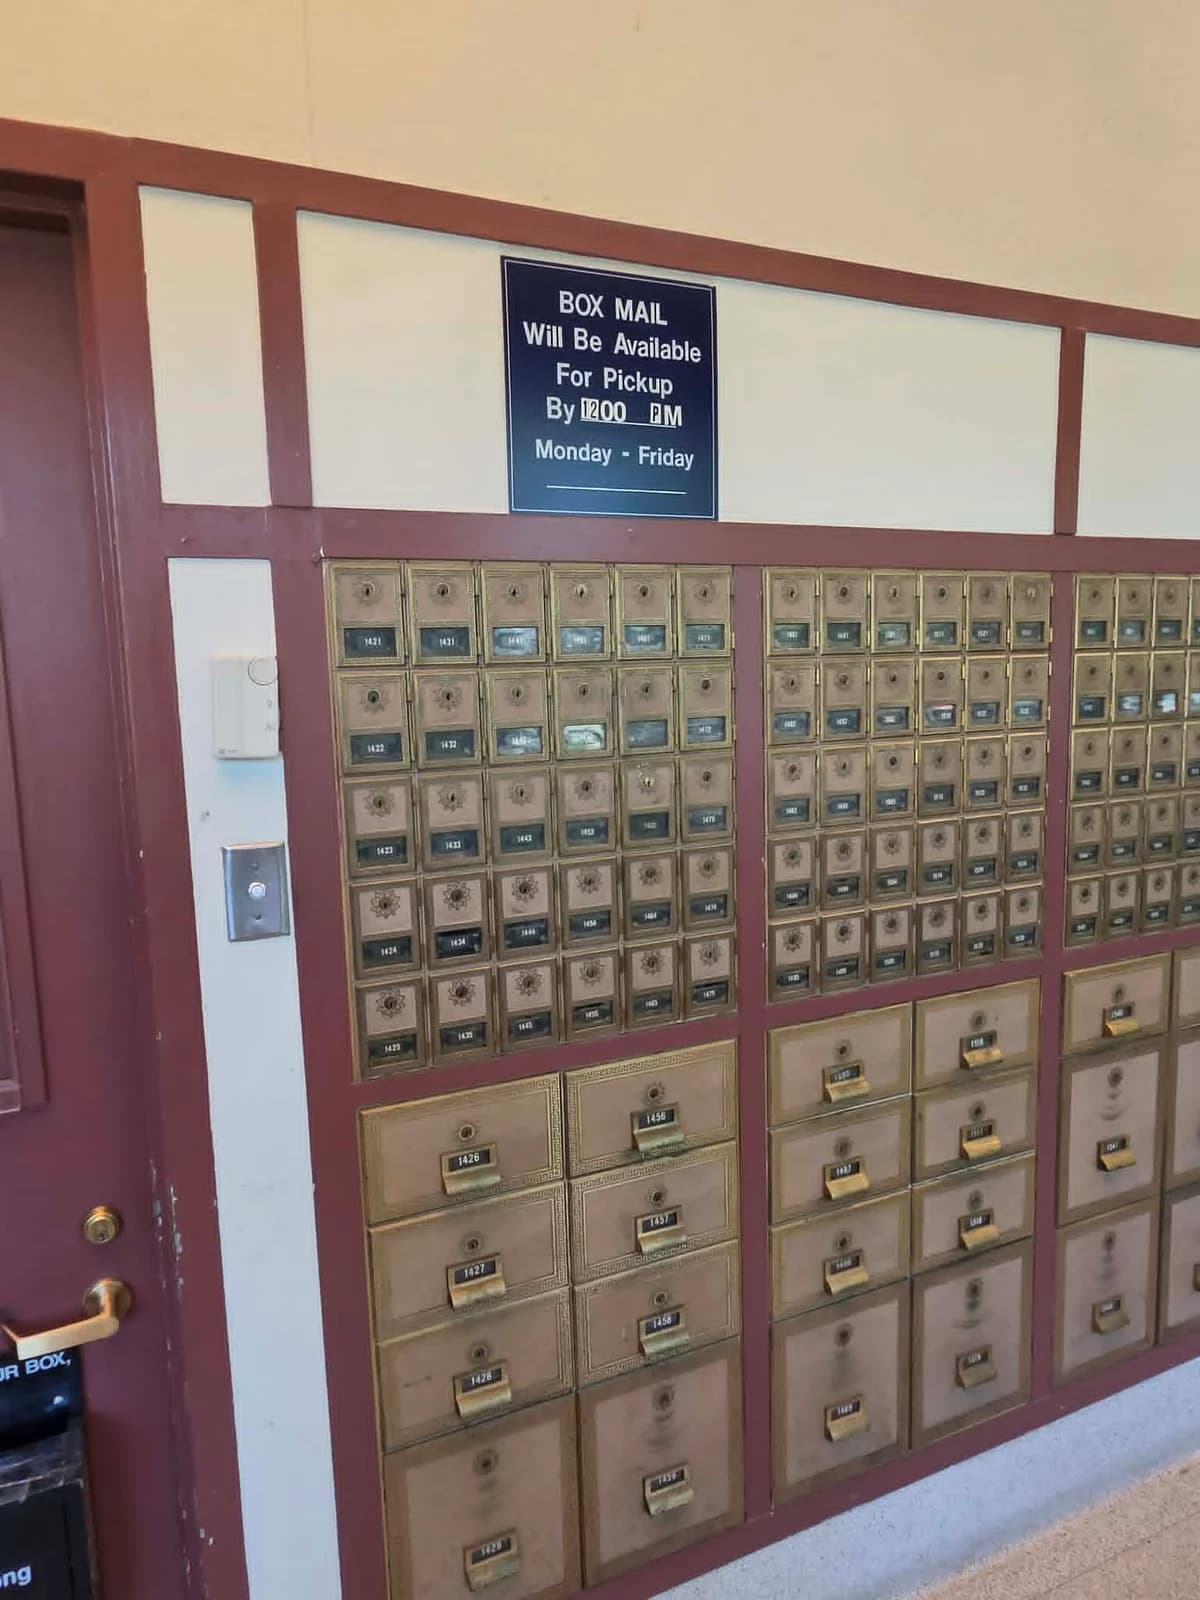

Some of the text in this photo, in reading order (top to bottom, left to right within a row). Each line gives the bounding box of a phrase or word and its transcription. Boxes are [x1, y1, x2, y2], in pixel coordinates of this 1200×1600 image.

[559, 290, 668, 326] BOX MAIL
[523, 321, 701, 363] Will Be Available
[557, 362, 673, 399] For Pickup
[546, 396, 575, 425] By
[650, 402, 682, 427] PM
[535, 439, 612, 466] Monday
[639, 446, 694, 471] Friday
[364, 637, 382, 646] 1421
[439, 638, 455, 646] 1431
[367, 744, 384, 753] 1422
[377, 846, 393, 855] 1423
[450, 938, 466, 947] 1434
[381, 947, 397, 956] 1424
[646, 1112, 666, 1124] 1456
[458, 1152, 480, 1166] 1426
[650, 1215, 669, 1227] 1457
[464, 1263, 485, 1278] 1427
[25, 1352, 71, 1375] BOX,
[470, 1371, 492, 1386] 1428
[0, 1565, 32, 1588] ng
